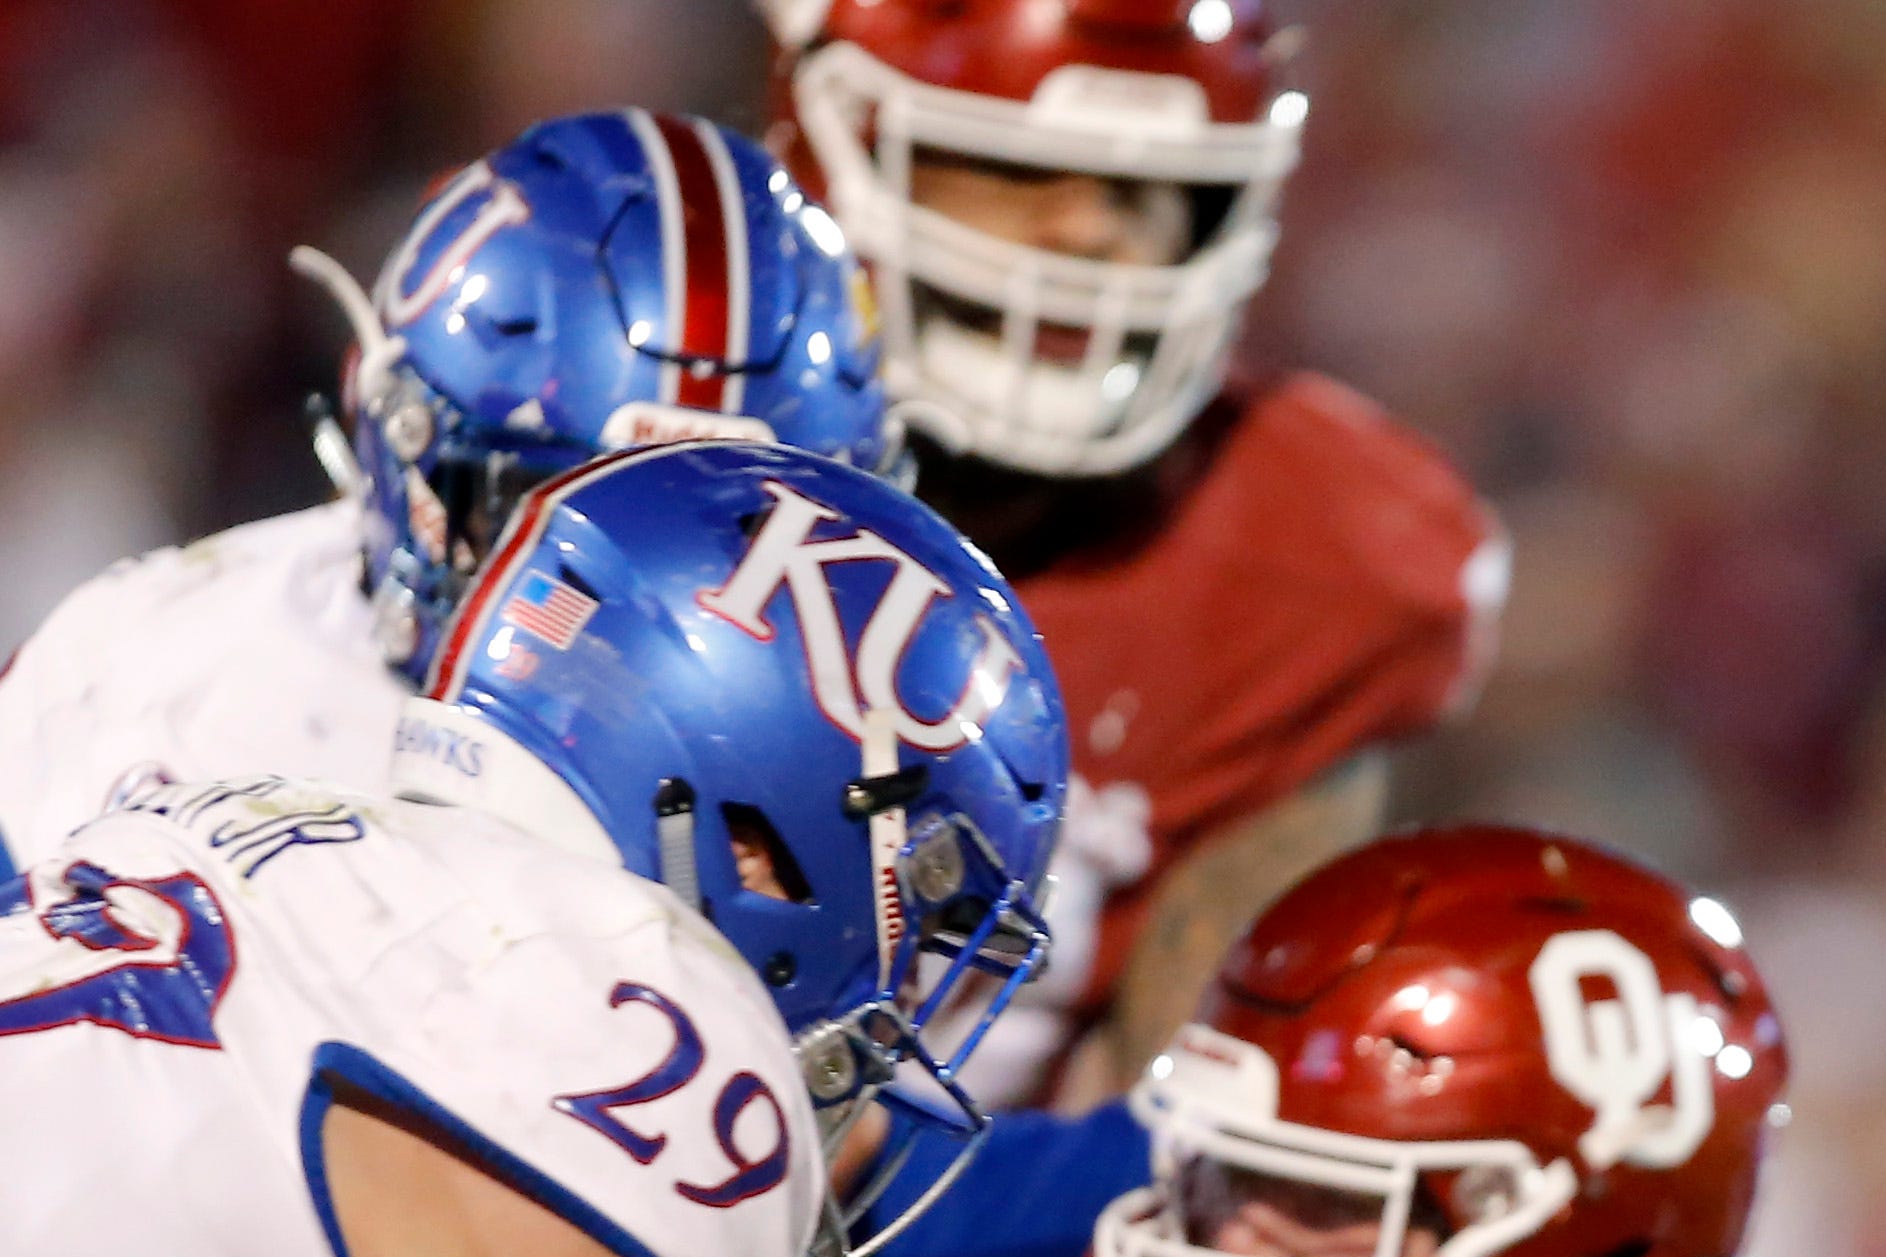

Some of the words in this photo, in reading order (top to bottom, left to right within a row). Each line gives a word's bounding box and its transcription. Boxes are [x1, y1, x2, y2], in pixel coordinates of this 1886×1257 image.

[694, 477, 1027, 754] KU
[550, 980, 790, 1209] 29
[1527, 928, 1716, 1170] OU
